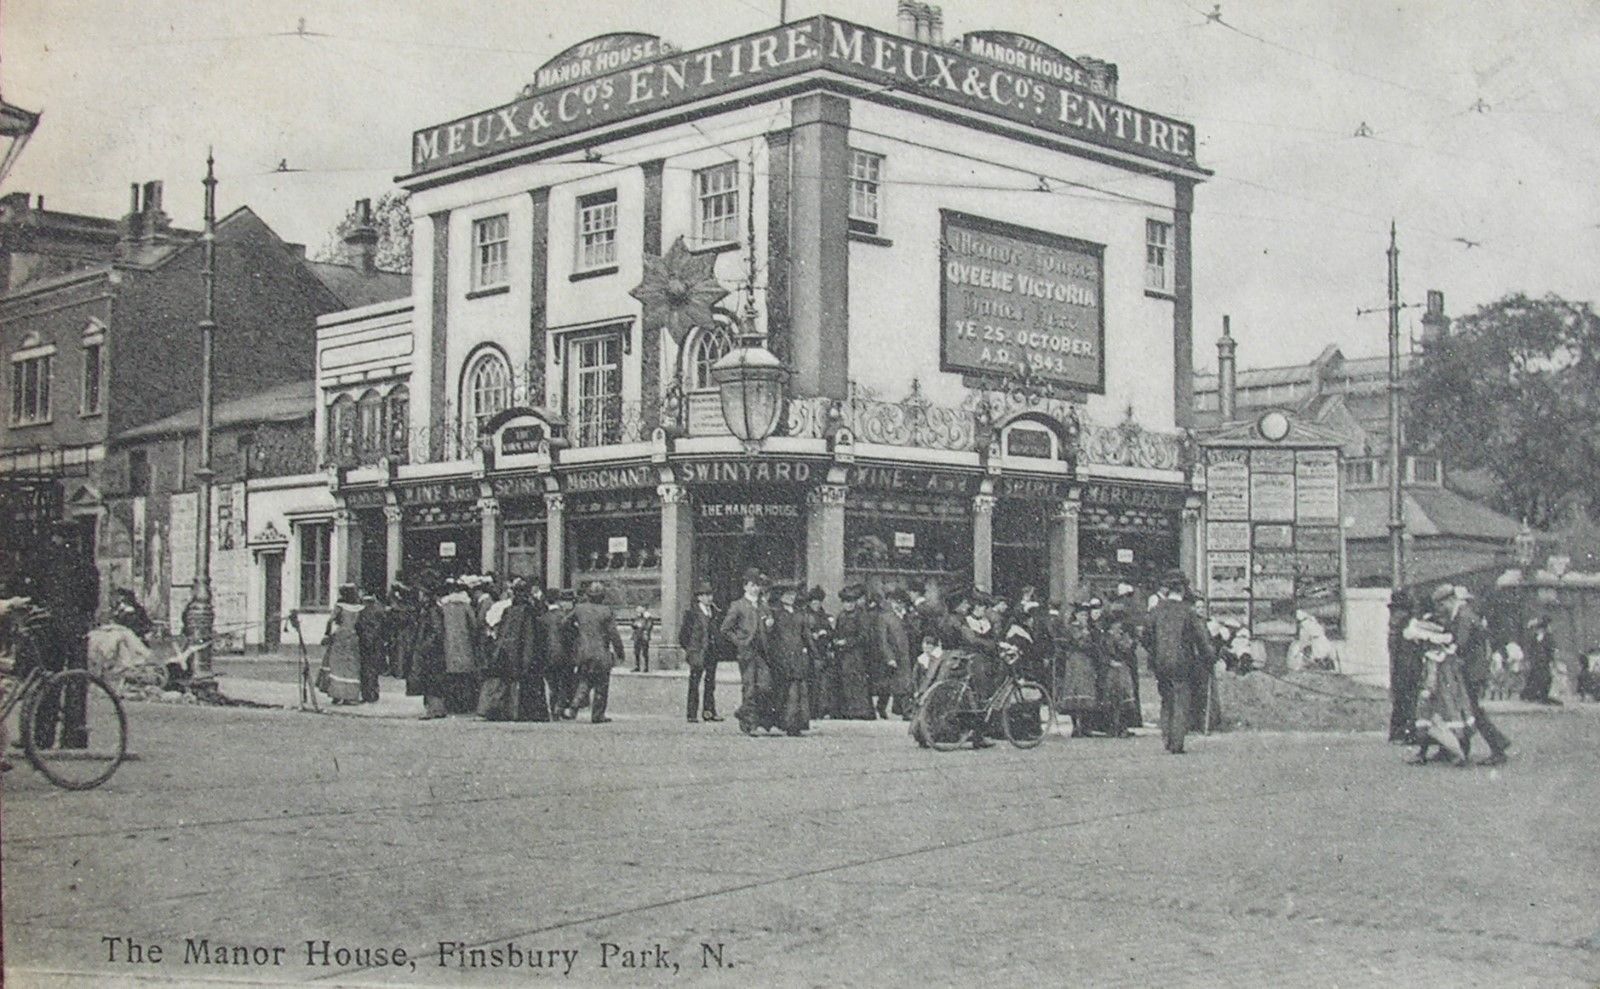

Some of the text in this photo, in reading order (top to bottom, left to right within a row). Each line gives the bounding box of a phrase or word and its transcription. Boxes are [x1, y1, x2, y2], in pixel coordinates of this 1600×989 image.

[537, 40, 658, 88] MANOR HOUSE
[829, 21, 960, 92] MEUX
[962, 66, 990, 100] &
[970, 36, 1027, 70] MANOR
[416, 106, 523, 164] MEUX
[528, 101, 551, 132] &
[1017, 273, 1097, 308] VICTORIA
[956, 320, 977, 339] YE
[682, 462, 810, 481] SWINYARD
[702, 504, 723, 517] THE
[725, 503, 763, 517] MANOR
